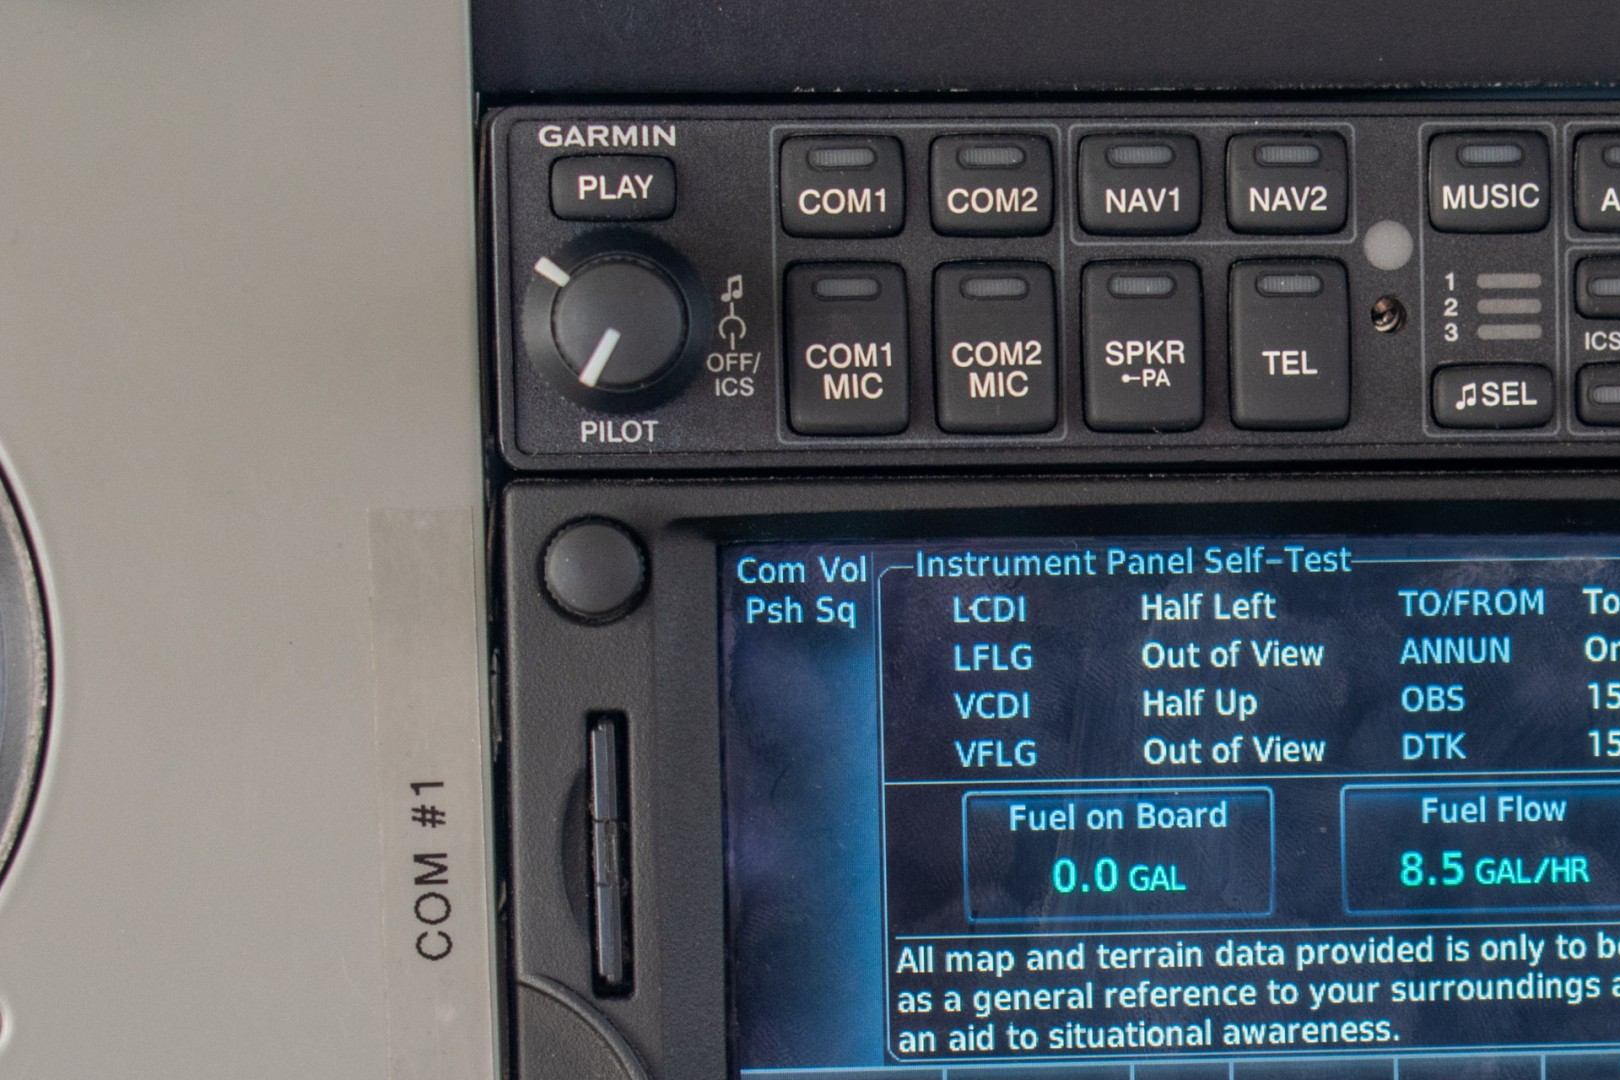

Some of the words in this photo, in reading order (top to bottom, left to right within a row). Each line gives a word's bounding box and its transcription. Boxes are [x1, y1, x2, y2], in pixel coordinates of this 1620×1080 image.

[538, 125, 676, 151] GARMIN
[578, 175, 653, 199] PLAY
[799, 188, 886, 214] COM1
[947, 187, 1038, 213] COM2
[1105, 187, 1180, 213] NAV1
[1249, 186, 1328, 212] NAV2
[1442, 183, 1539, 210] MUSIC
[1445, 273, 1455, 291] 1
[1444, 298, 1458, 317] 2
[1444, 323, 1458, 342] 3
[1105, 340, 1185, 366] SPKR
[1262, 351, 1318, 375] TEL
[1481, 382, 1537, 408] SEL
[580, 421, 658, 444] PILOT
[737, 558, 805, 584] Com
[818, 556, 867, 583] Vol
[916, 551, 1096, 578] Instrument
[1107, 548, 1193, 575] Panel
[1205, 545, 1352, 574] Self-Test
[746, 596, 803, 624] Psh
[815, 596, 856, 628] Sq
[953, 596, 1026, 623] LCDI
[1142, 594, 1203, 621] Half
[1215, 593, 1276, 620] Left
[1399, 588, 1544, 617] TO/FROM
[1583, 588, 1620, 615] To
[954, 644, 1033, 670] LFLG
[1142, 641, 1201, 669] Out
[1210, 640, 1240, 668] of
[1251, 639, 1324, 668] View
[1400, 637, 1510, 665] ANNUN
[954, 693, 1031, 719] VCDI
[1143, 689, 1203, 717] Half
[1216, 689, 1258, 720] Up
[1401, 685, 1465, 712] OBS
[1403, 732, 1466, 760] DTK
[411, 781, 445, 827] #1
[1010, 804, 1075, 831] Fuel
[1087, 805, 1124, 829] on
[1137, 801, 1228, 829] Board
[1421, 797, 1486, 824] Fuel
[1498, 796, 1567, 823] Flow
[1053, 858, 1117, 893] 0.0
[1129, 865, 1186, 891] GAL
[1401, 852, 1463, 887] 8.5
[1476, 856, 1590, 884] GAL/HR
[414, 853, 453, 961] COM
[897, 946, 933, 974] All
[946, 949, 1014, 977] map
[1026, 944, 1084, 970] and
[1097, 941, 1202, 970] terrain
[1215, 940, 1284, 967] data
[1297, 938, 1433, 971] provided
[1447, 936, 1469, 962] is
[1480, 933, 1544, 966] only
[1557, 935, 1586, 960] to
[900, 1031, 934, 1052] an
[949, 1024, 994, 1051] aid
[1007, 1026, 1038, 1049] to
[1049, 1019, 1211, 1048] situational
[1223, 1019, 1400, 1046] awareness.
